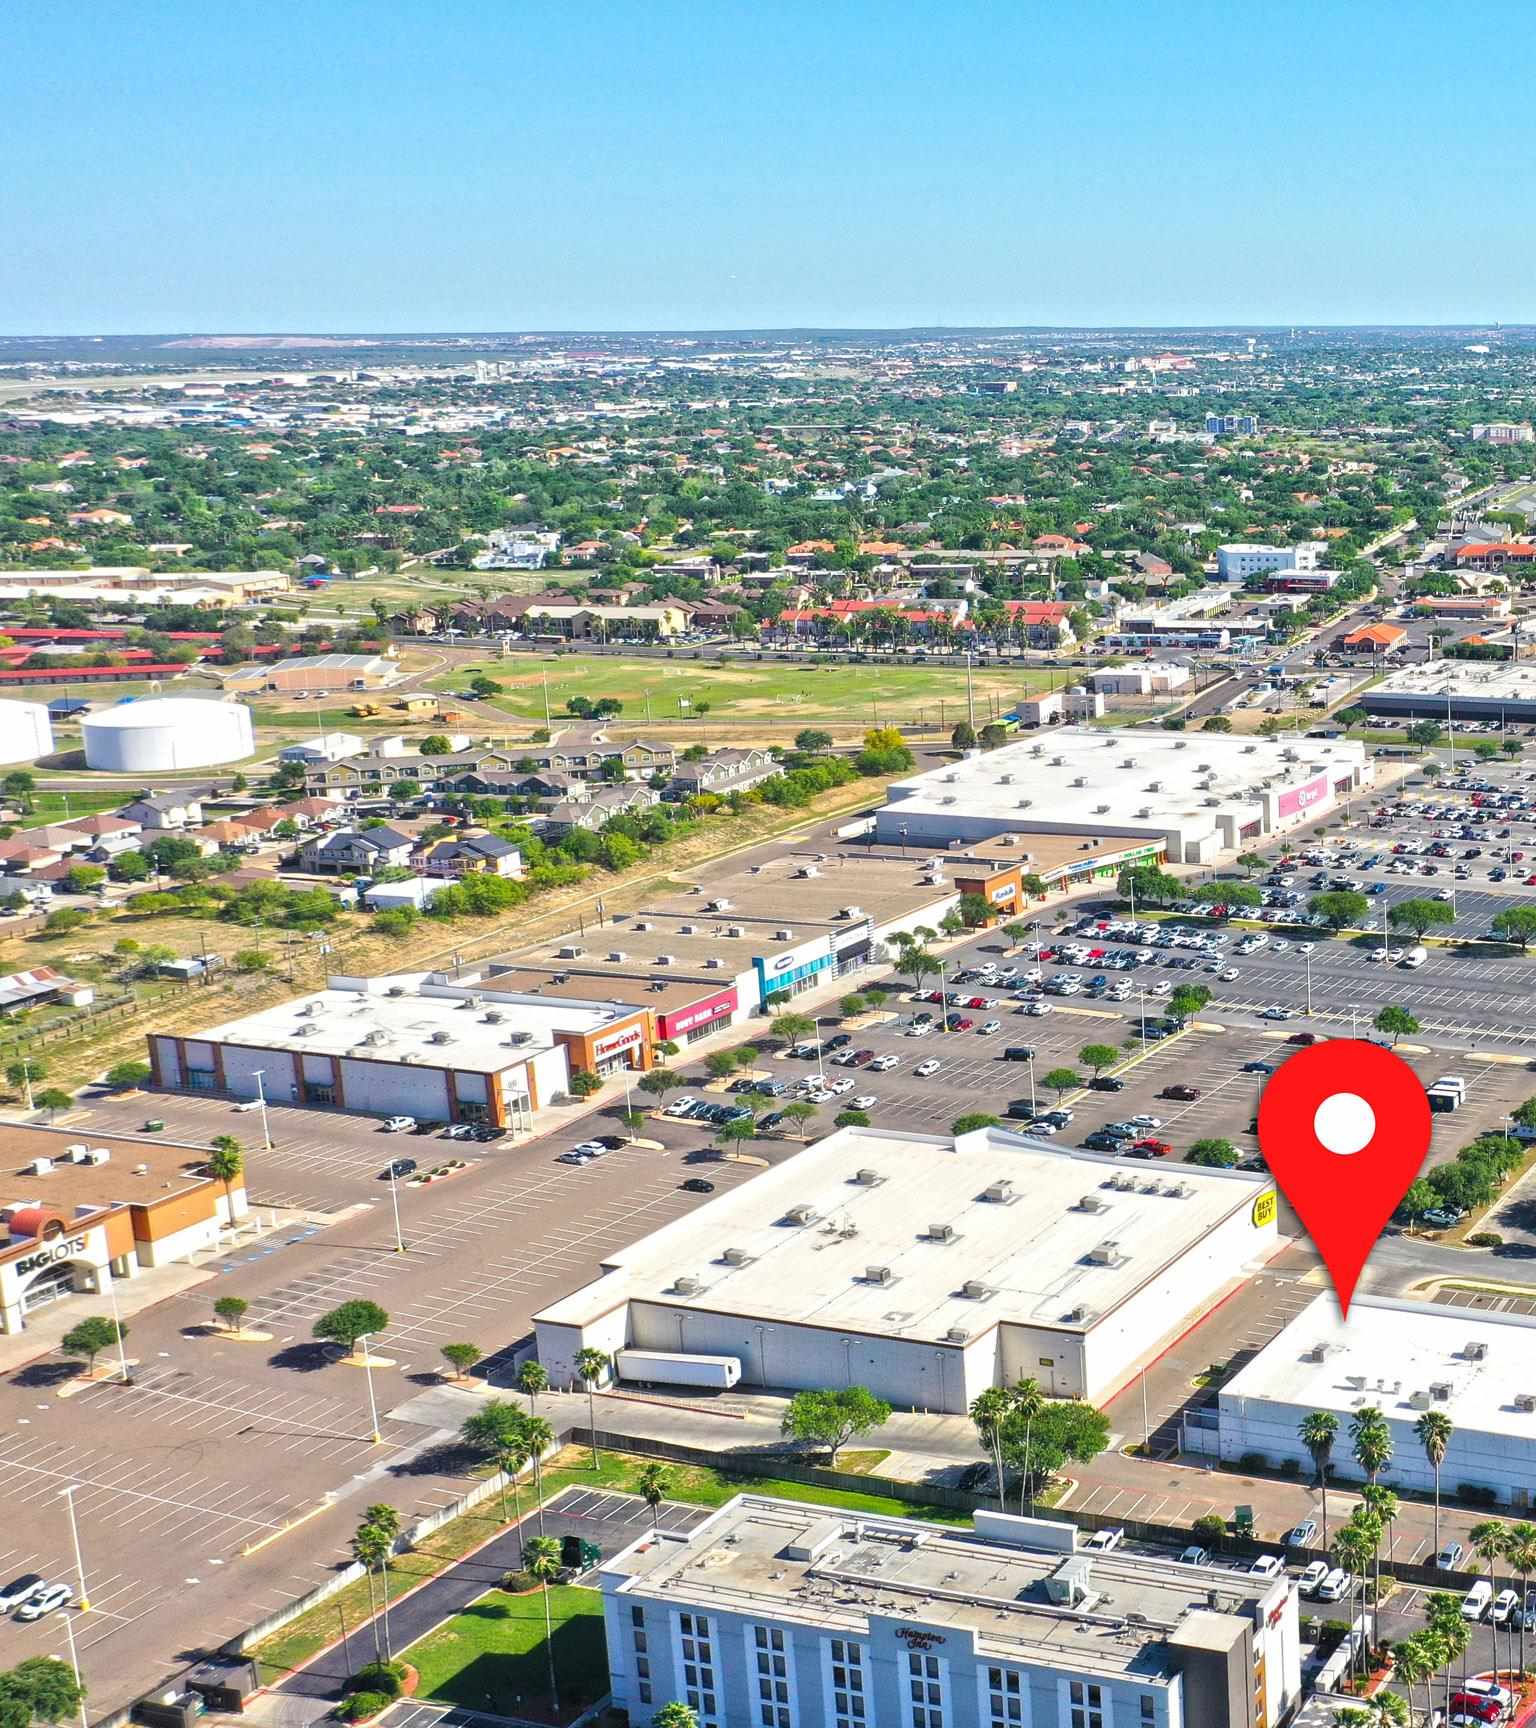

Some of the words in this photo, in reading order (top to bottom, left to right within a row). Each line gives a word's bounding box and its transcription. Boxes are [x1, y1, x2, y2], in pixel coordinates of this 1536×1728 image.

[1257, 1196, 1274, 1212] BEST
[1257, 1206, 1272, 1221] BUY
[895, 1627, 946, 1644] Hampton
